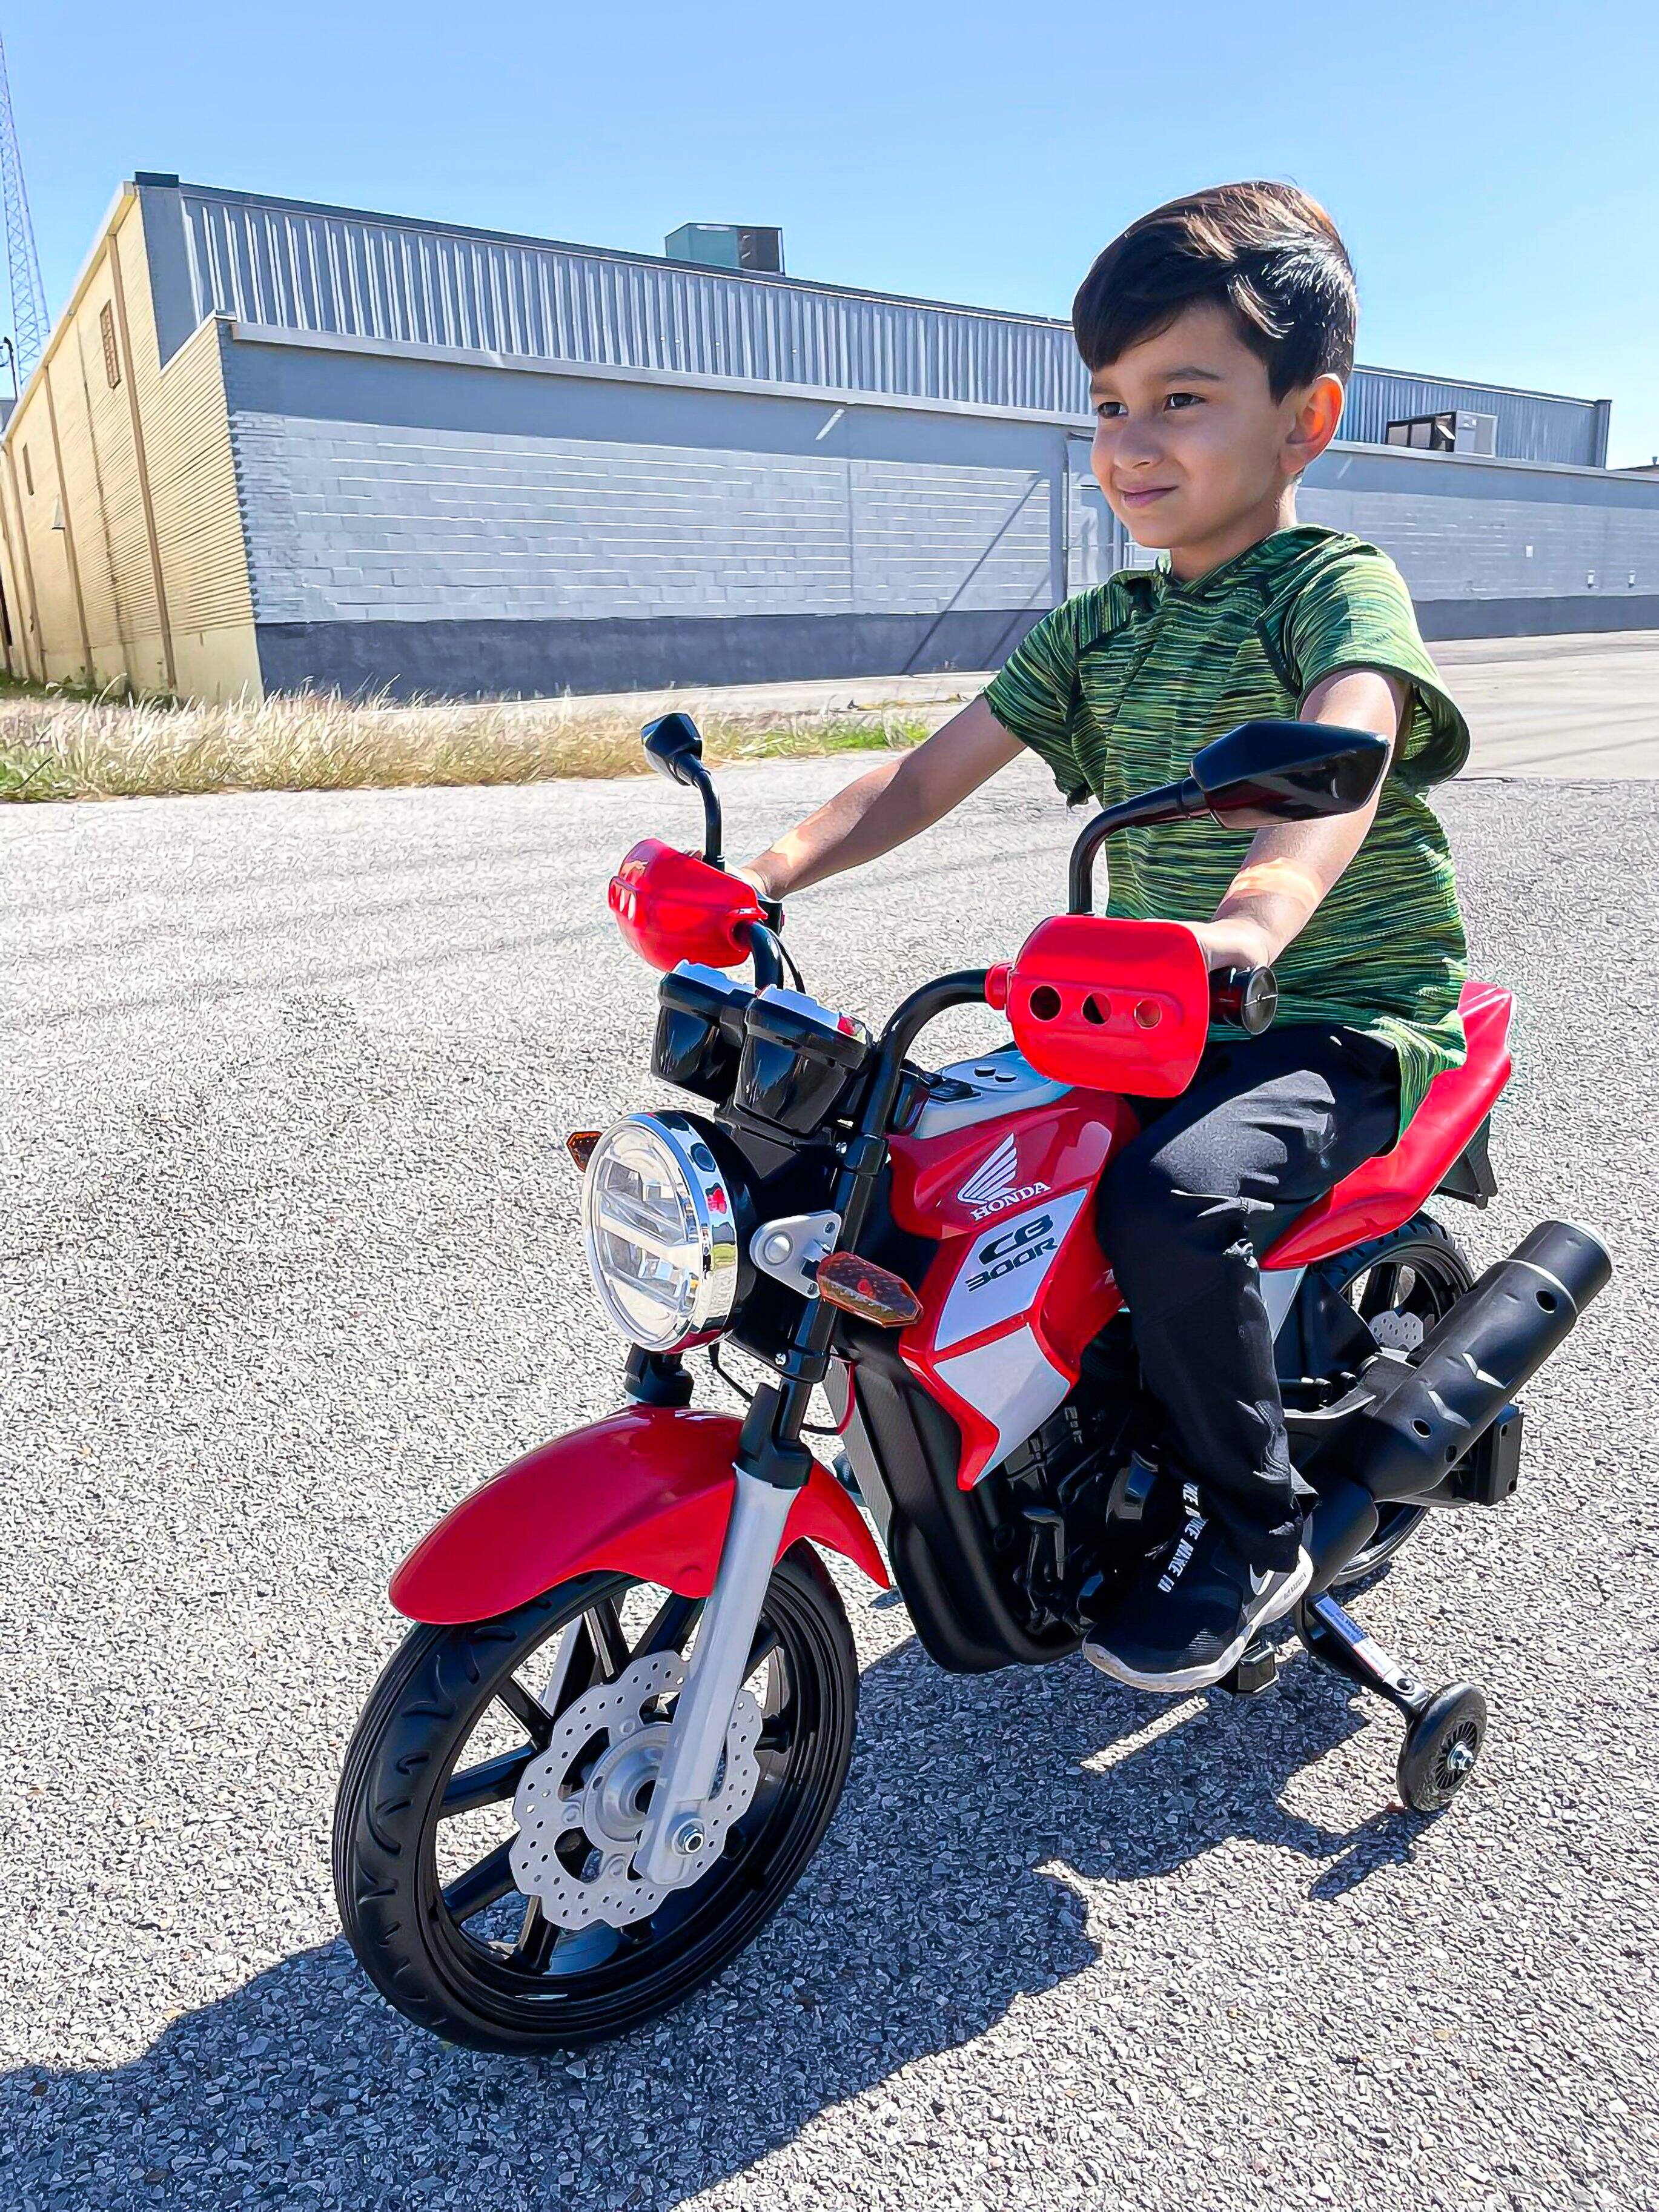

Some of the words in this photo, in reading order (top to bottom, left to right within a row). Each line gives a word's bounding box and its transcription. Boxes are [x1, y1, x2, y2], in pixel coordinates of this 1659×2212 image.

[970, 1182, 1051, 1221] HONDA
[978, 1214, 1054, 1265] CB
[964, 1237, 1058, 1292] 300R
[1168, 1538, 1194, 1577] NIKE
